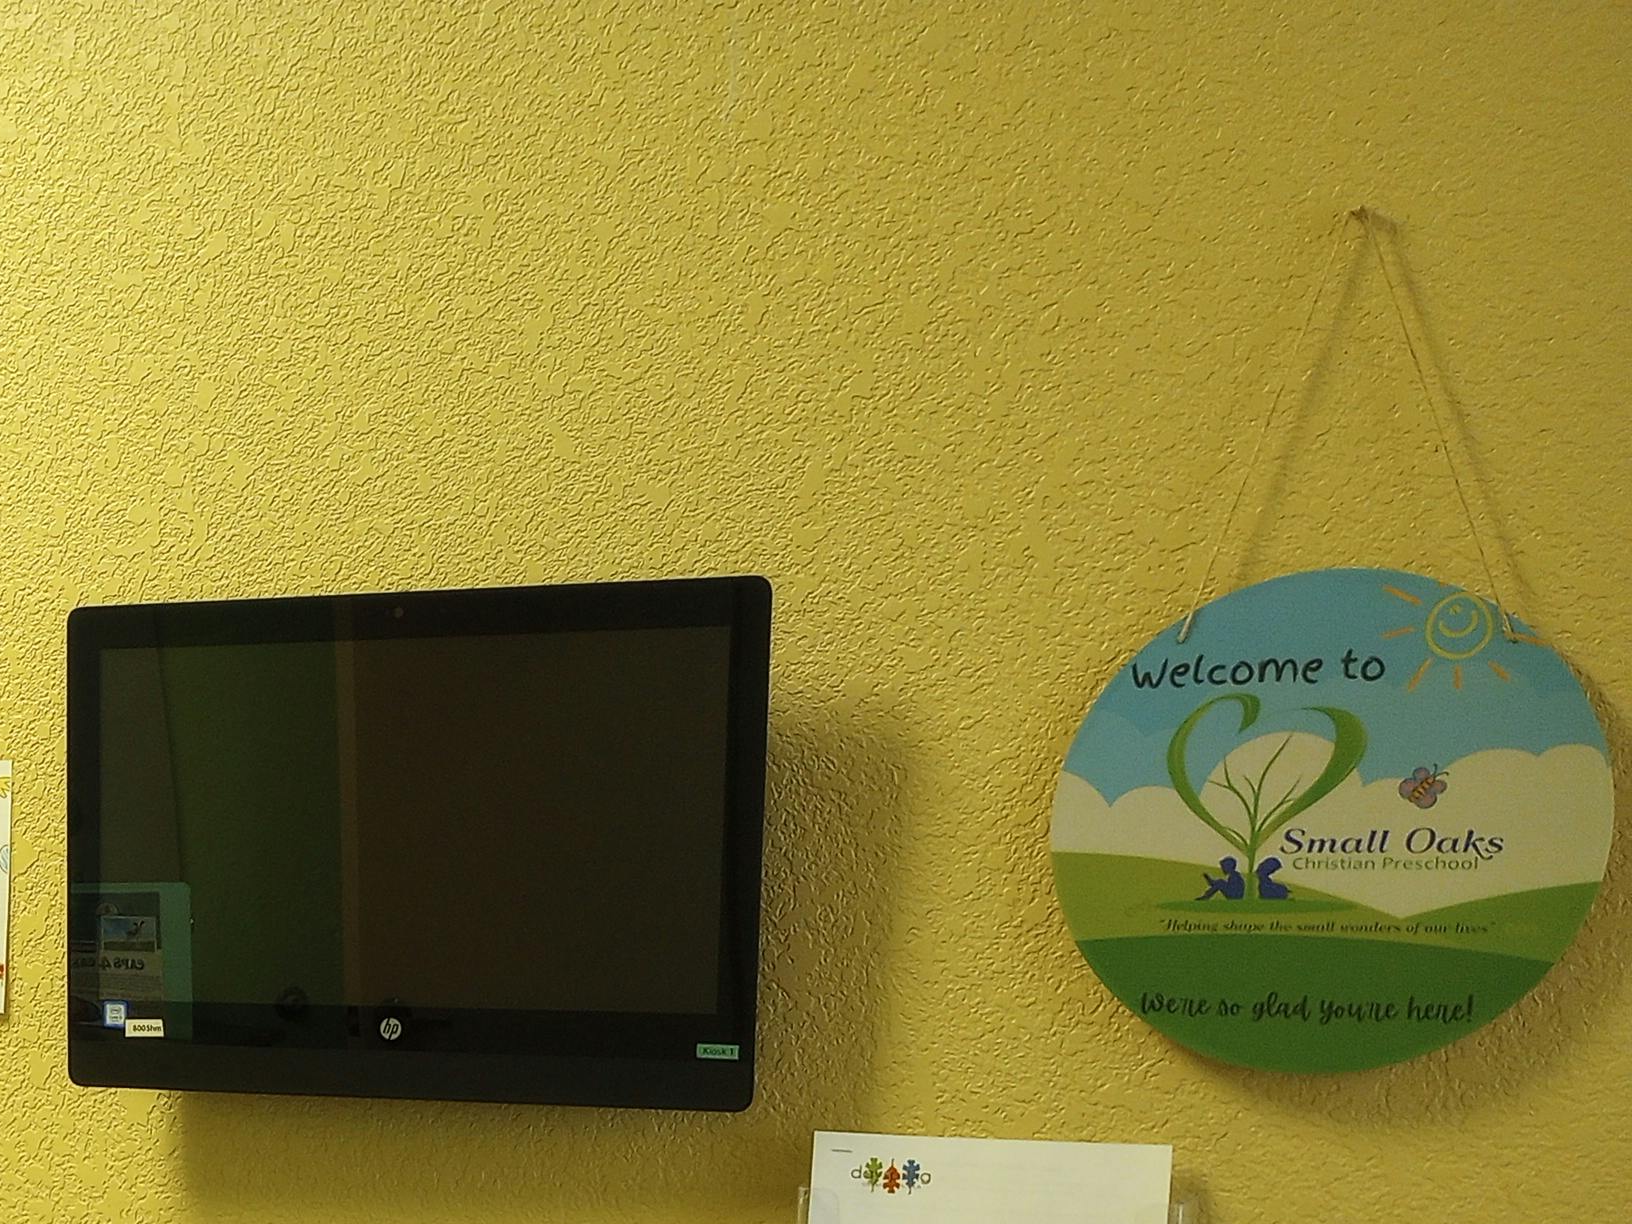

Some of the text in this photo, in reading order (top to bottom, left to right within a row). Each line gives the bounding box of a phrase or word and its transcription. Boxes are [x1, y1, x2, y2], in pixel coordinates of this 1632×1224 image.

[1132, 648, 1386, 690] Welcome to
[1280, 827, 1504, 860] Small Oaks
[1292, 856, 1478, 870] Christian Preschool
[1222, 922, 1265, 934] shape
[1268, 919, 1294, 931] the
[1296, 920, 1336, 932] small
[1339, 922, 1402, 934] wonders
[1405, 921, 1419, 935] of
[1218, 998, 1242, 1015] so
[1252, 992, 1311, 1022] glad
[1406, 995, 1475, 1023] here!
